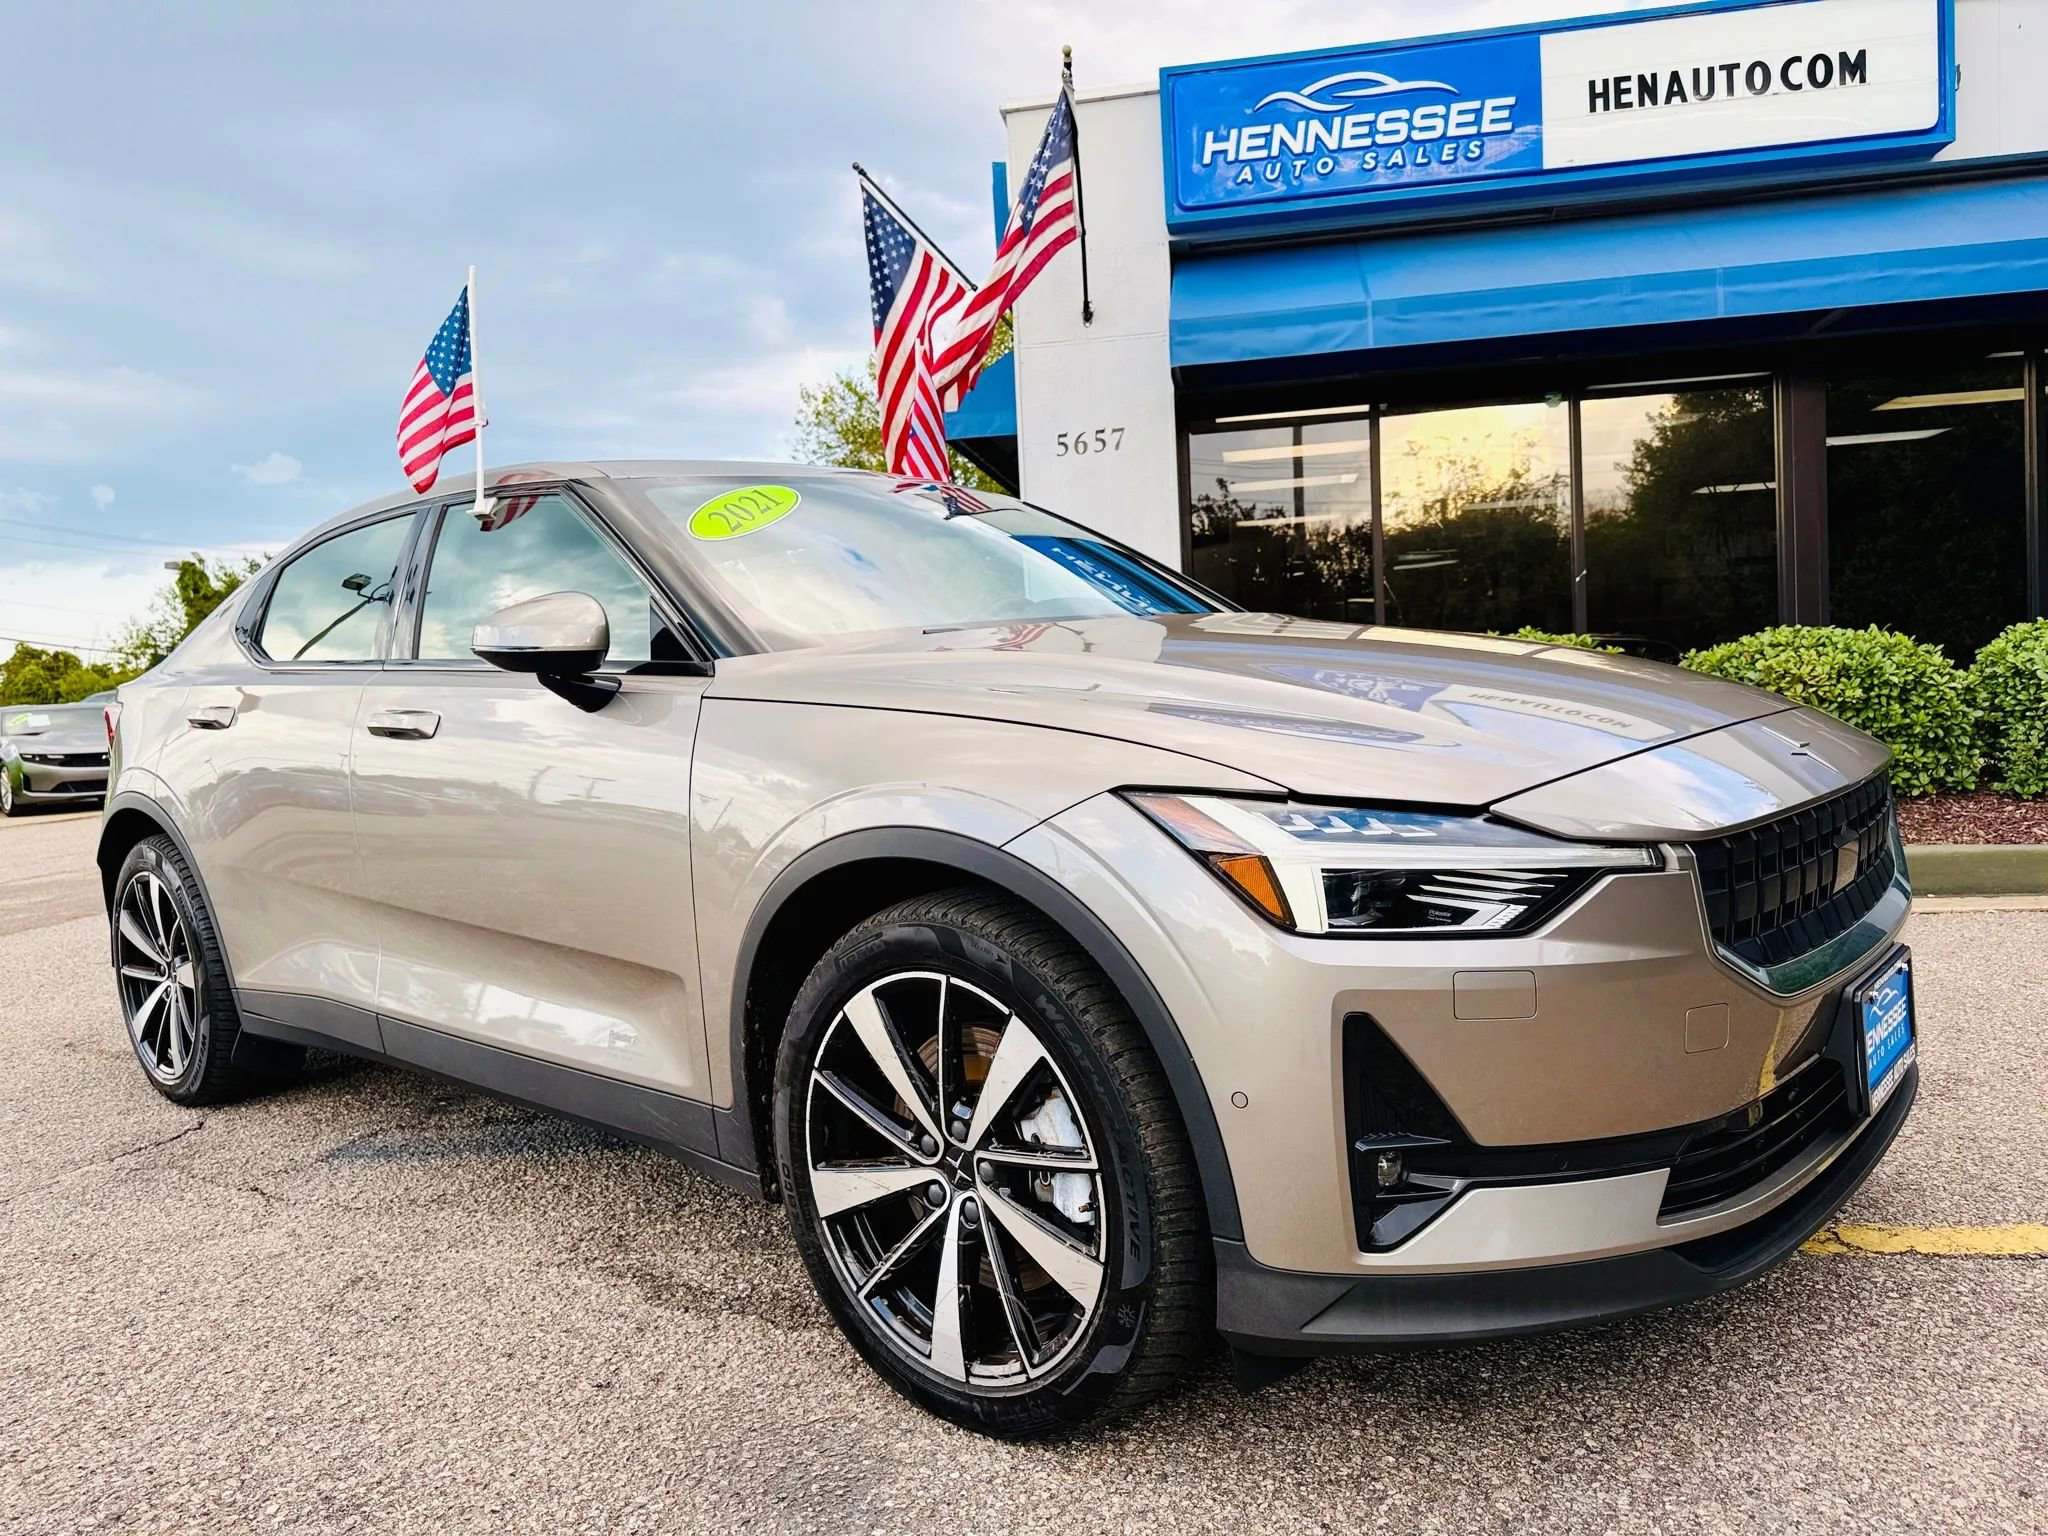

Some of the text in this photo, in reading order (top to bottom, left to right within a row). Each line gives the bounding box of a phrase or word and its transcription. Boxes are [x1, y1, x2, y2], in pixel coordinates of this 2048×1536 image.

[1202, 96, 1517, 165] HENNESSEE
[1236, 140, 1485, 183] AUTO SALES
[1056, 427, 1125, 457] 5657
[708, 489, 784, 532] 2021
